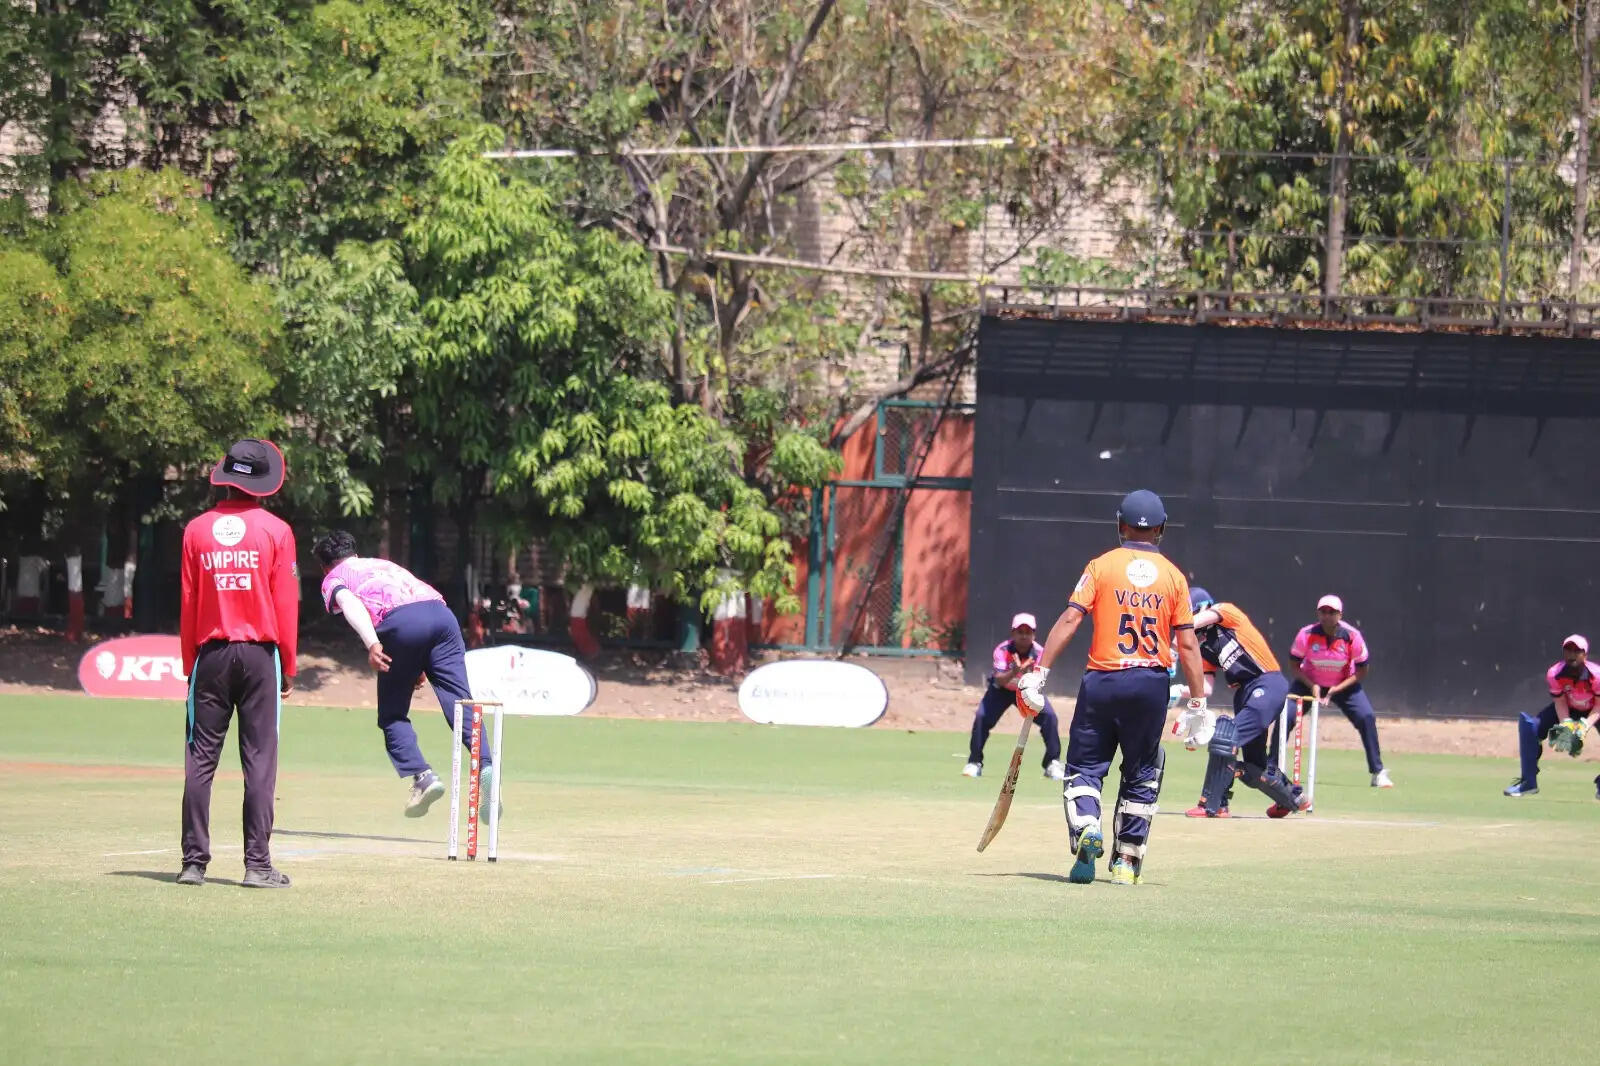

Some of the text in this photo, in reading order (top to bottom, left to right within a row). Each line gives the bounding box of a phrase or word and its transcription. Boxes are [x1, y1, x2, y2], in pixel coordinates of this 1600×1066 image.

[200, 550, 260, 571] UMPIRE
[214, 575, 248, 590] KFC
[1114, 588, 1164, 610] VICKY
[1117, 613, 1160, 656] 55
[468, 728, 480, 849] KFC KFC KFC
